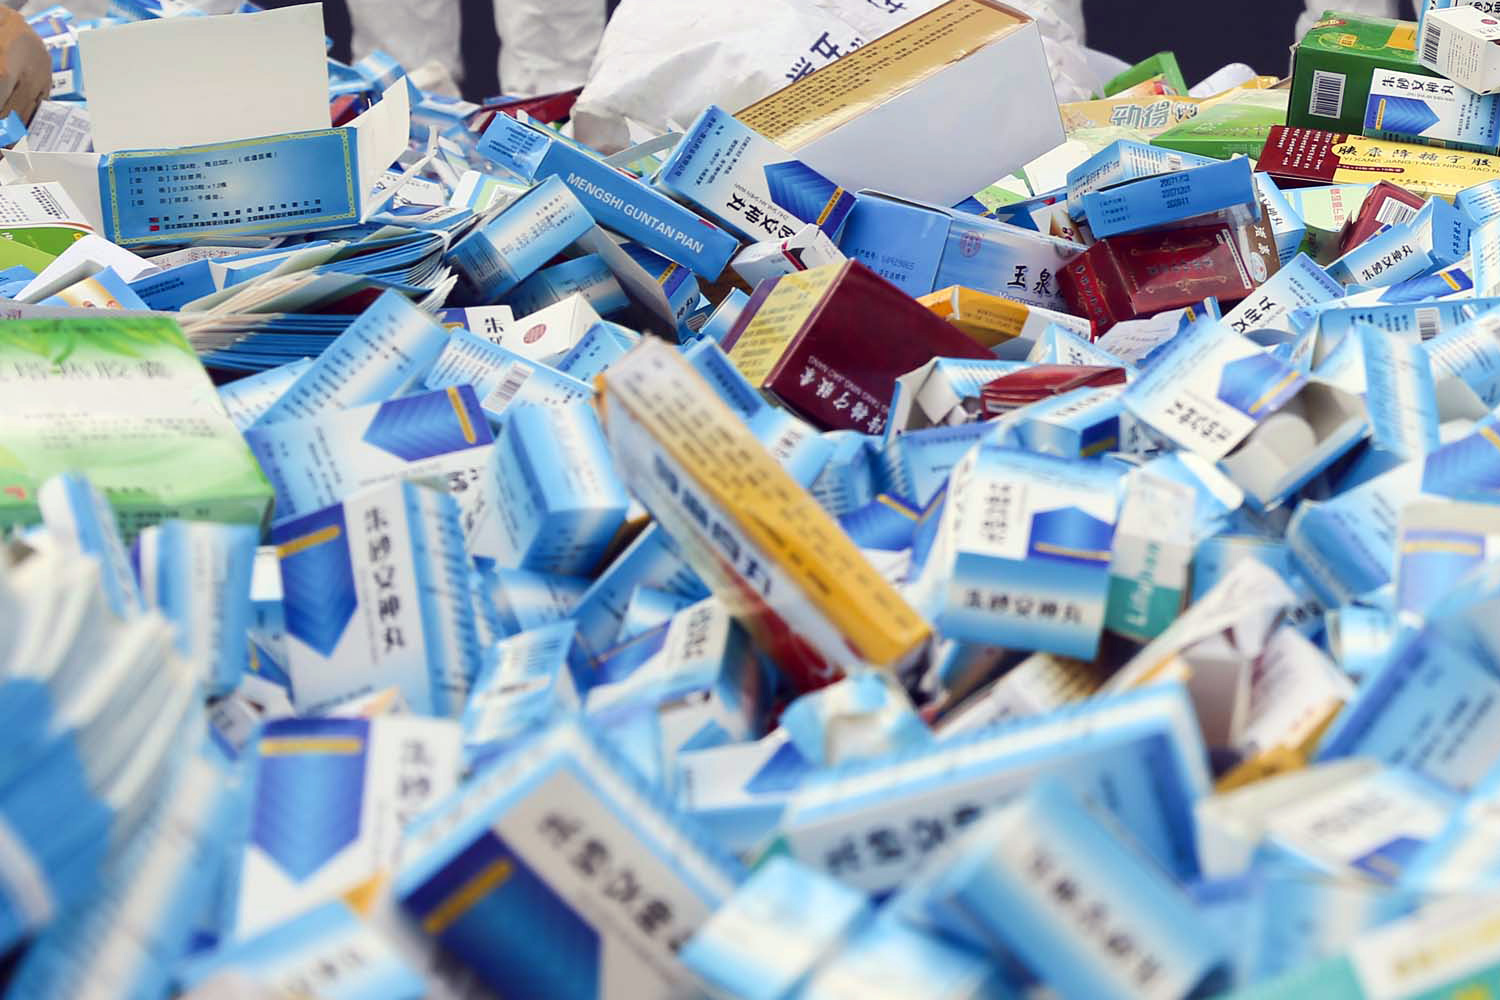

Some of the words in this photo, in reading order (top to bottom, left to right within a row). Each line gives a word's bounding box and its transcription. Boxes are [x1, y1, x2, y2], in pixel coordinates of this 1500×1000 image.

[1382, 75, 1455, 96] 朱砂安神丸
[566, 172, 625, 211] MENGSHI
[623, 204, 675, 238] GUNTAN
[676, 231, 705, 255] PIAN
[1363, 245, 1413, 281] 朱砂安神丸
[1007, 265, 1063, 297] 玉泉
